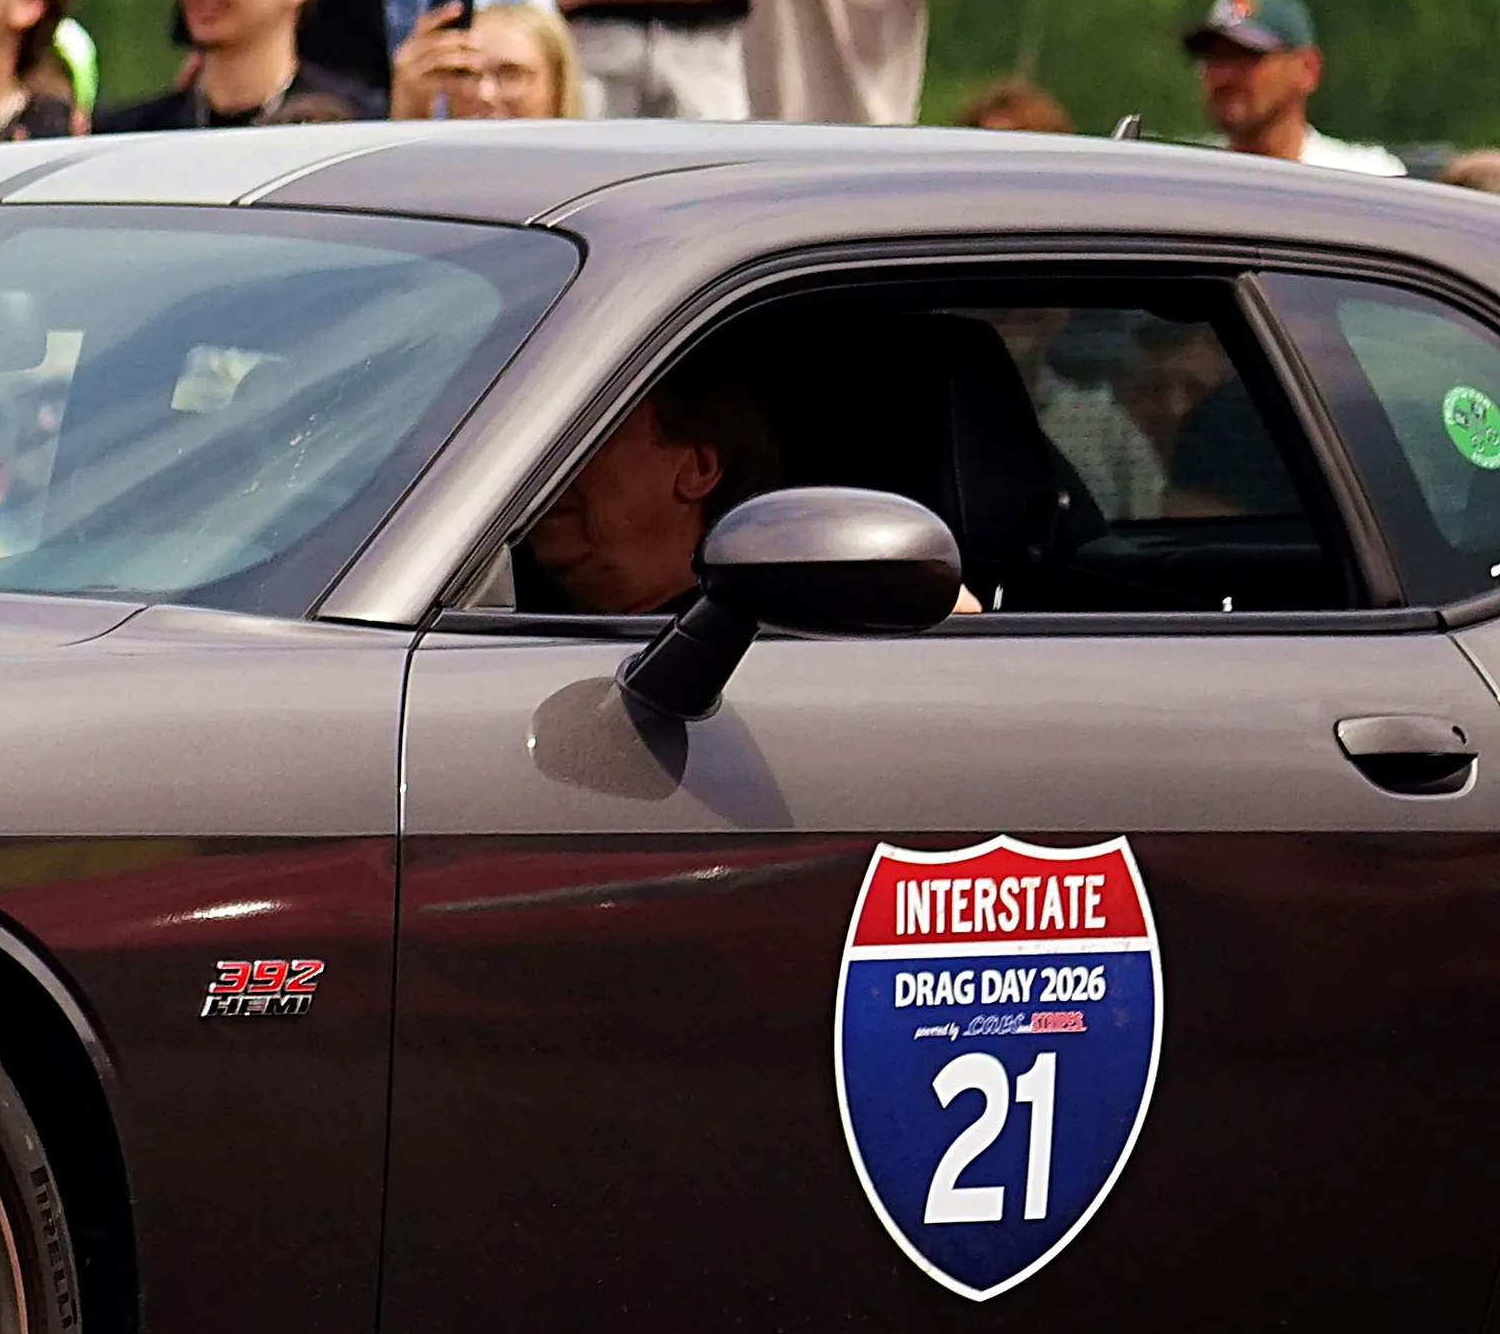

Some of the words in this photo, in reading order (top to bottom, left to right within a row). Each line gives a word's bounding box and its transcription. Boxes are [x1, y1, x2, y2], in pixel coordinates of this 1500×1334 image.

[894, 874, 1107, 936] INTERSTATE
[207, 959, 326, 994] 392
[894, 970, 975, 1008] DRAG
[980, 967, 1037, 1005] DAY
[1039, 964, 1107, 1003] 2026
[200, 994, 313, 1018] HEMI
[923, 1051, 1058, 1225] 21
[30, 1163, 78, 1330] PIRELLI
